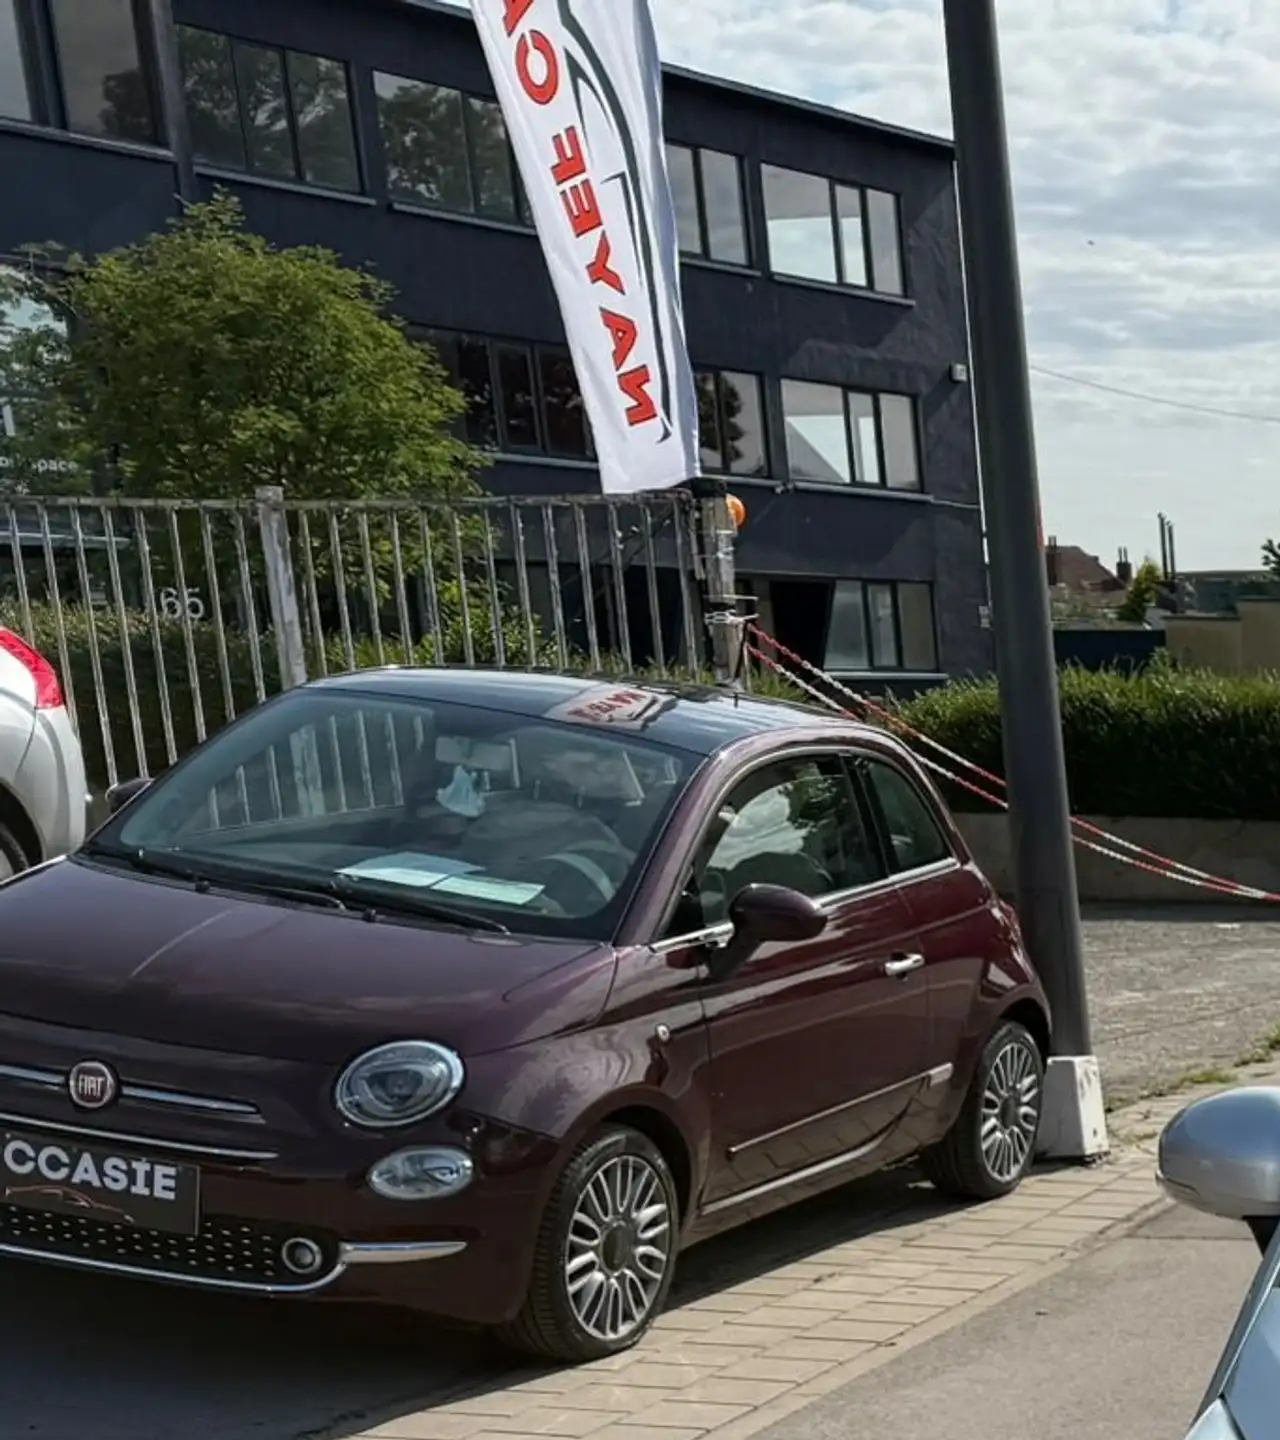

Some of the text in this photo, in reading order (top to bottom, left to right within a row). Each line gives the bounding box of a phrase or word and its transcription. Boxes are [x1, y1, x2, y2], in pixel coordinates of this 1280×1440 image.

[160, 586, 204, 618] 65
[79, 1073, 106, 1098] FIAT
[3, 1139, 178, 1200] CCASIE
